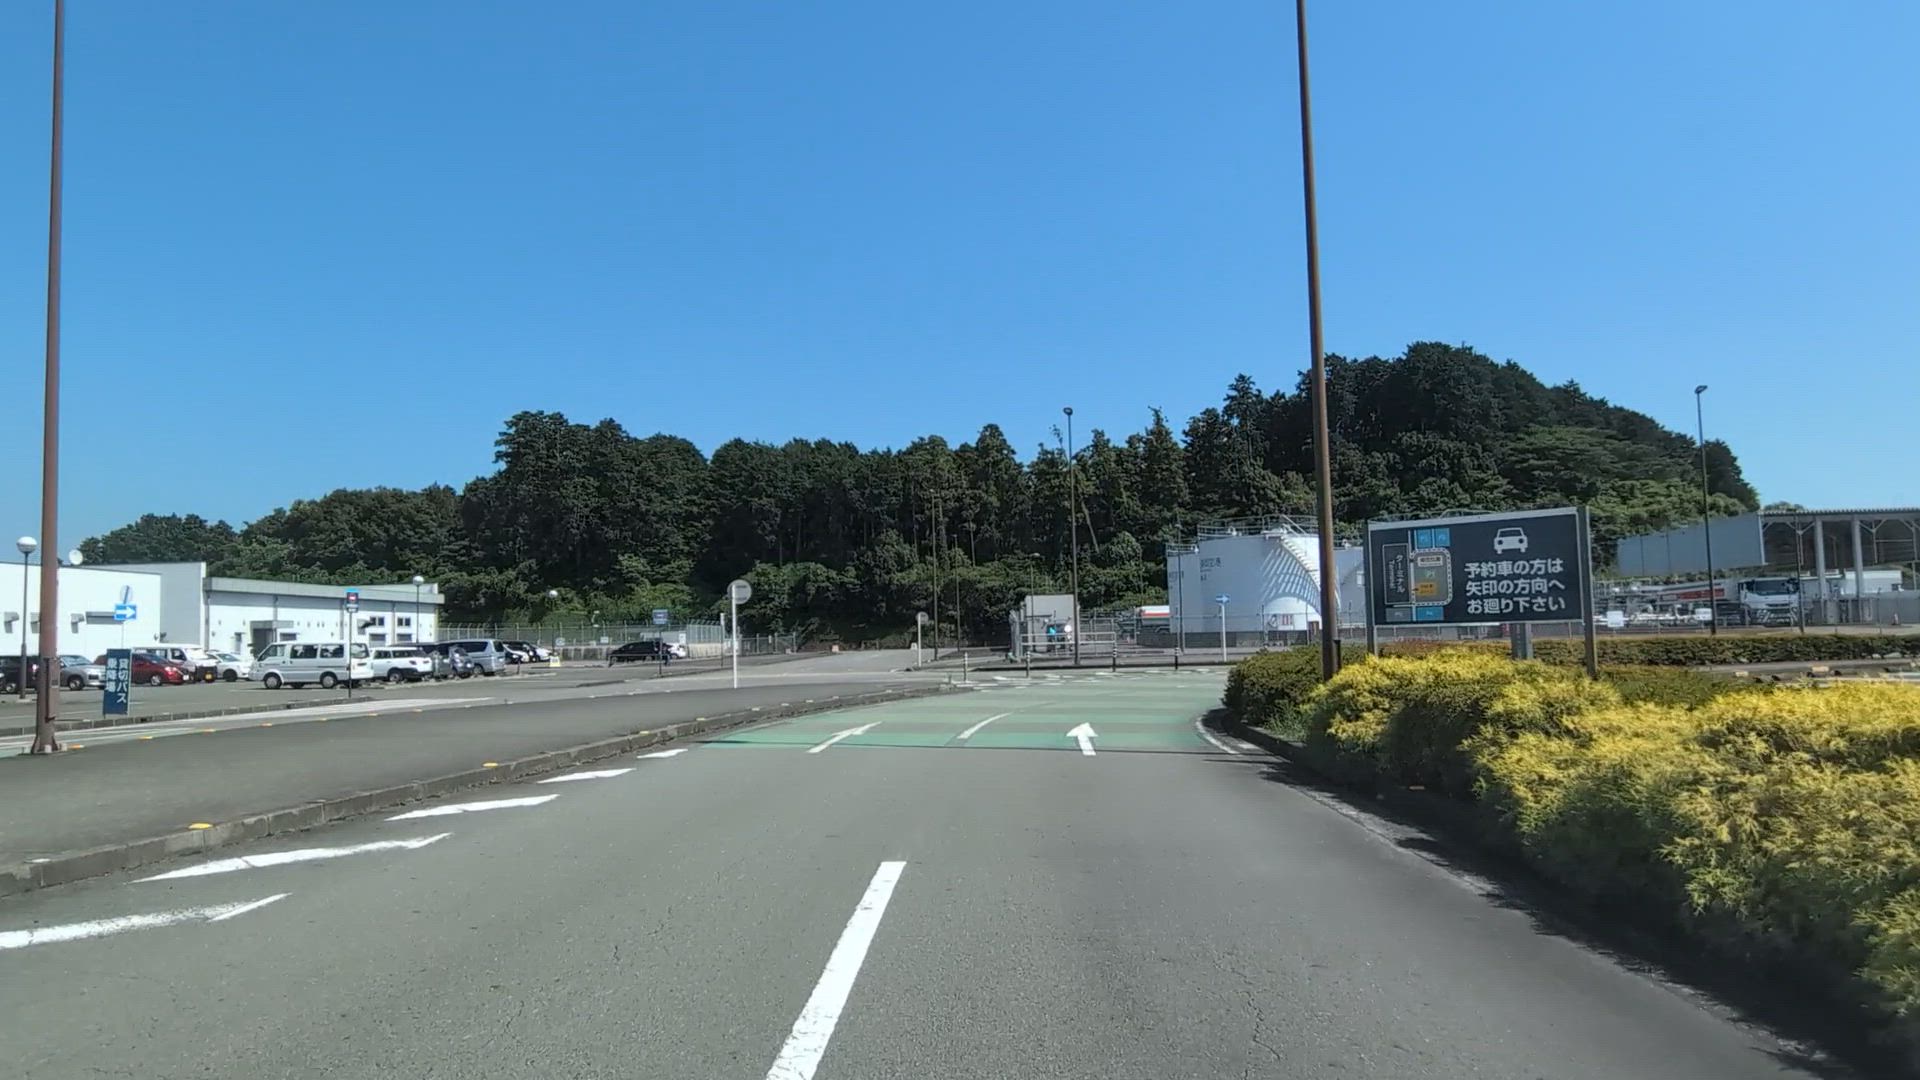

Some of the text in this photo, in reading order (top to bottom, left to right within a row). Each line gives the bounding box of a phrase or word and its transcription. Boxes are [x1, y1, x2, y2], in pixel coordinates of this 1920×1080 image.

[1396, 554, 1406, 593] ターミナル
[1464, 558, 1563, 578] 予約車の方は
[1466, 579, 1565, 597] 矢印の方向へ
[1467, 597, 1565, 615] お廻り下さい
[117, 658, 129, 703] 貸切バス
